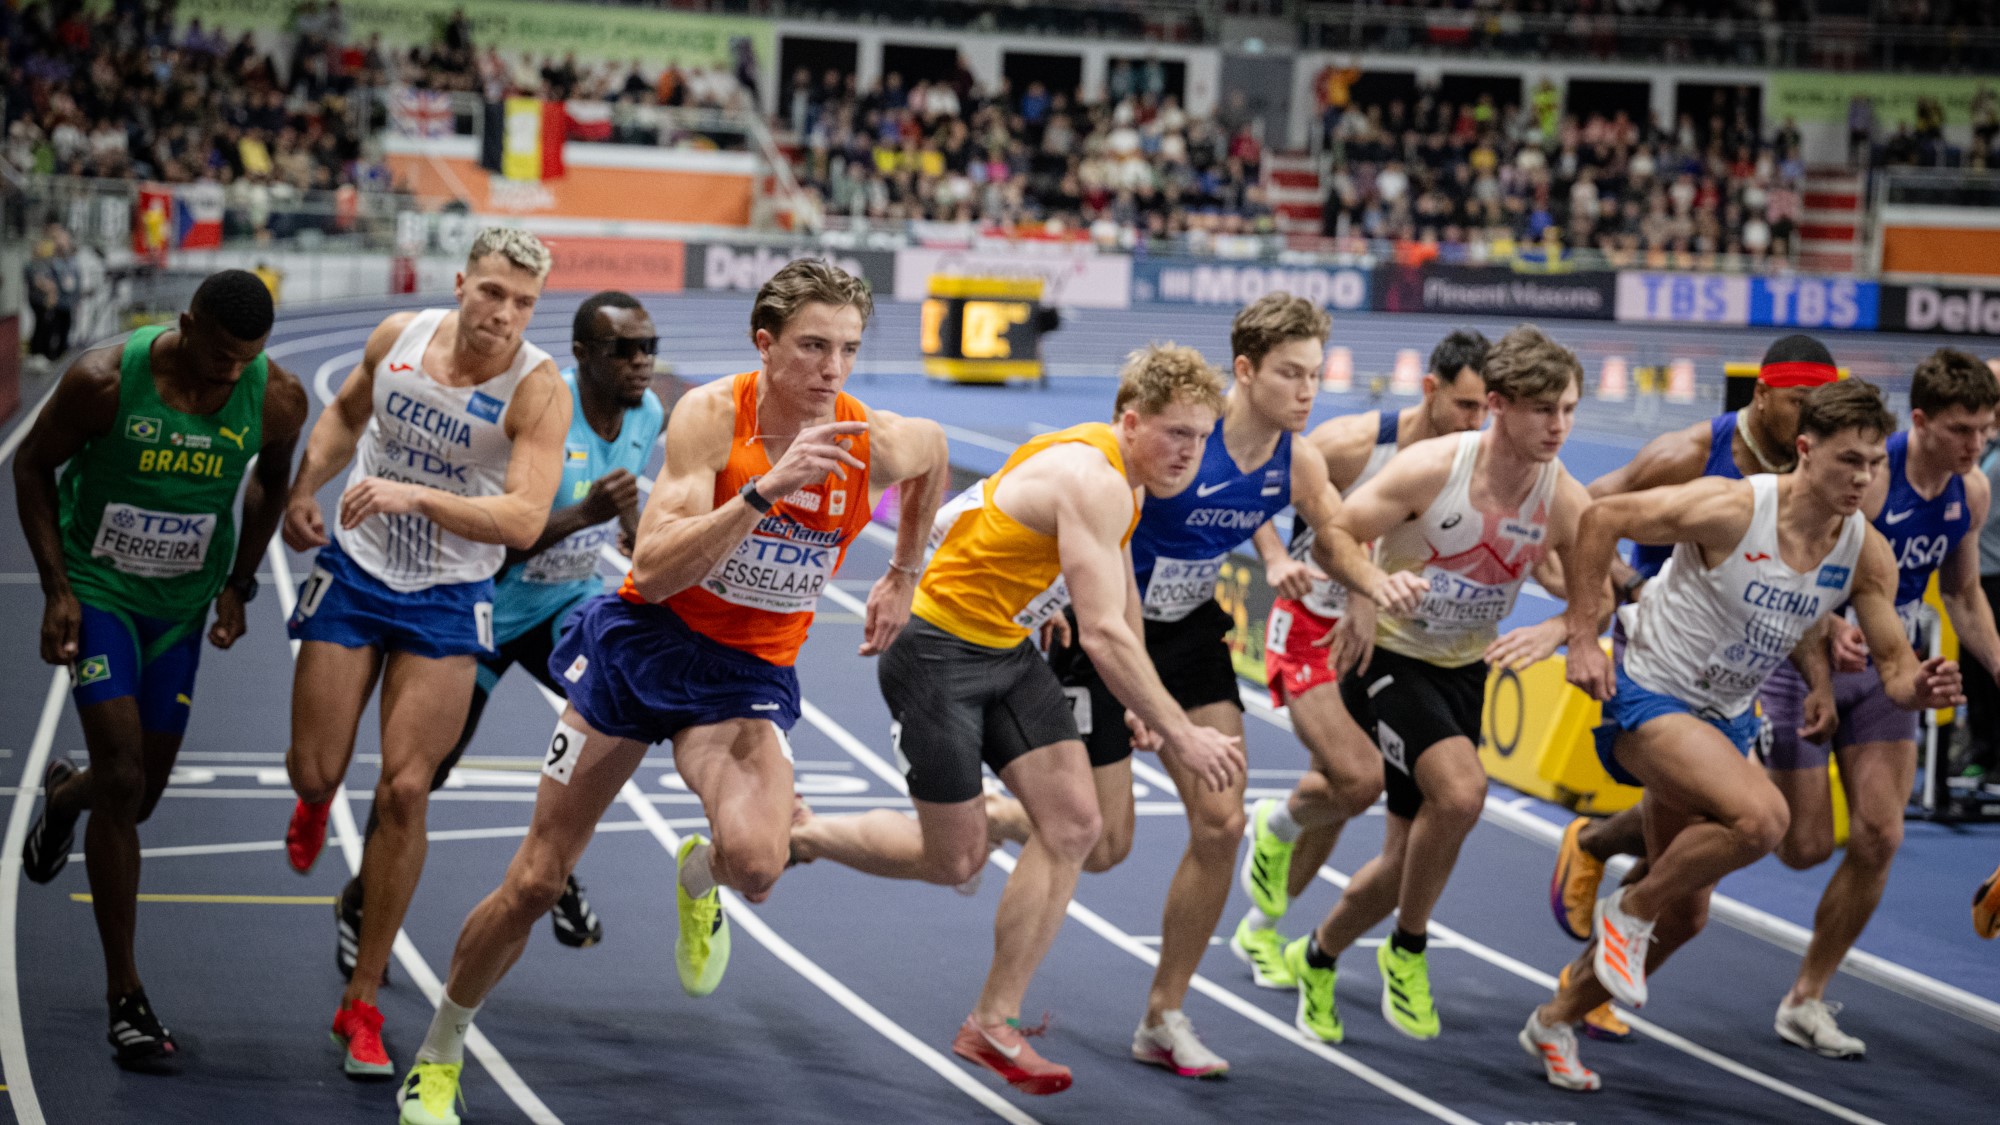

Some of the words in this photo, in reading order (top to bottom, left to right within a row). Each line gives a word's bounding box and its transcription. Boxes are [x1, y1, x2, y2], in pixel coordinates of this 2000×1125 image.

[1193, 265, 1365, 309] MONDO
[1640, 275, 1727, 318] TBS
[1766, 277, 1859, 327] TBS
[386, 390, 471, 449] CZECHIA
[139, 450, 223, 478] BRASIL
[402, 446, 467, 484] TDK
[138, 512, 206, 536] TDK
[1185, 508, 1266, 530] ESTONIA
[102, 528, 200, 560] FERREIRA
[752, 538, 829, 568] TDK
[1888, 533, 1949, 570] USA
[722, 558, 824, 594] ESSELAAR
[1743, 580, 1820, 618] CZECHIA
